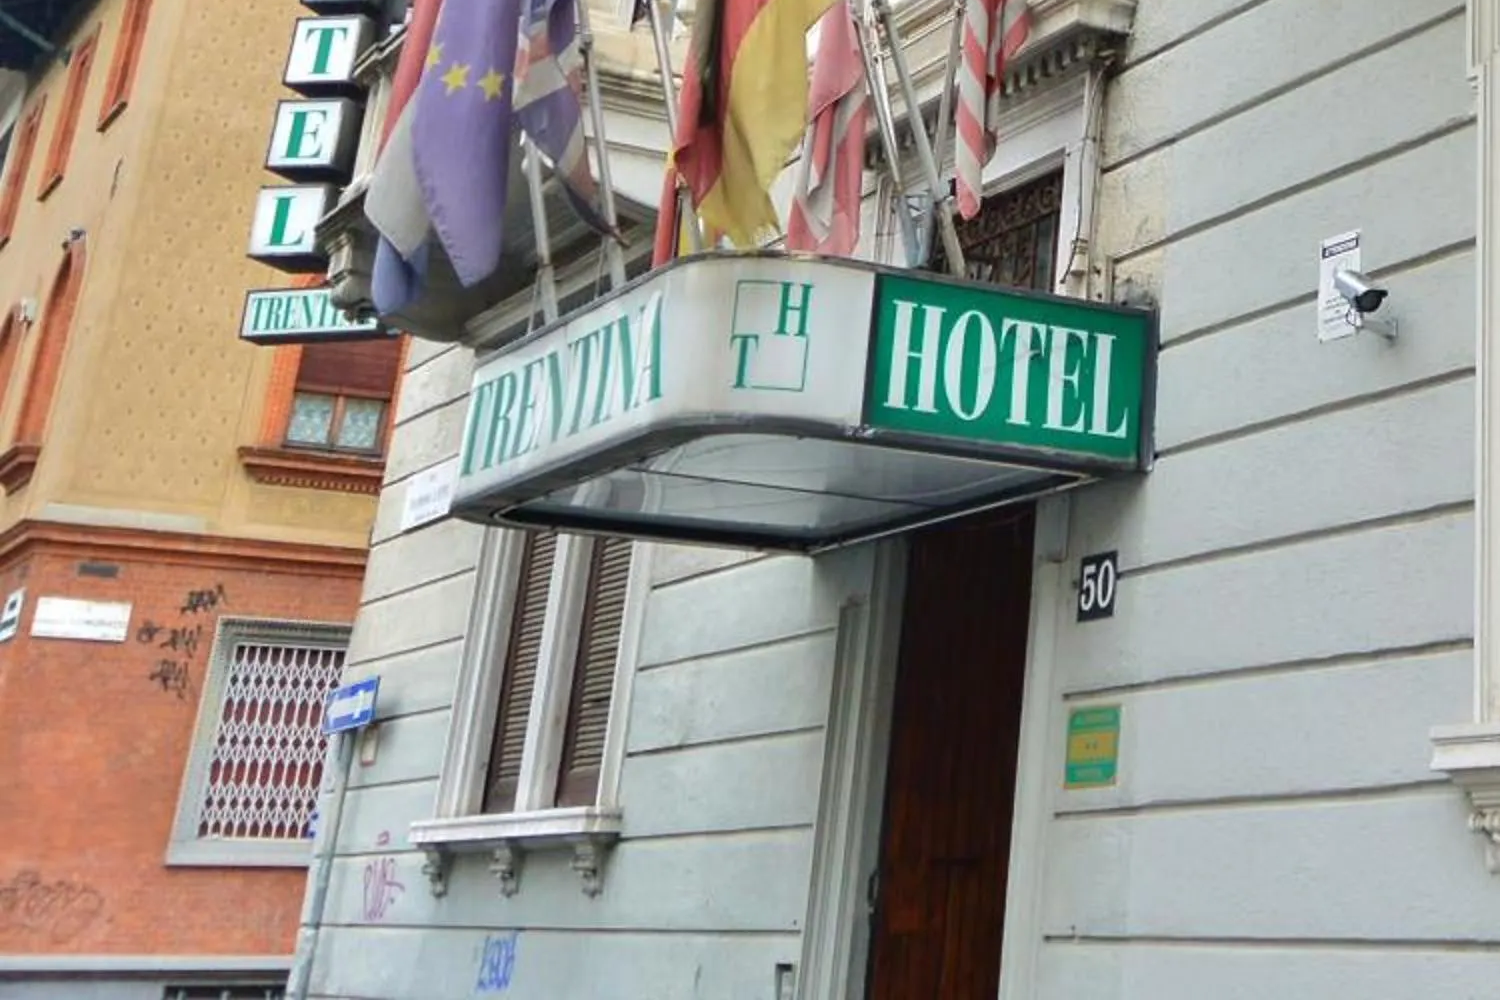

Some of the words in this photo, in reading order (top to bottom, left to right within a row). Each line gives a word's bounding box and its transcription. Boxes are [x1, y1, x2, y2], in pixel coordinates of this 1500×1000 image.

[252, 294, 370, 331] TRENT
[775, 282, 814, 335] H
[461, 292, 663, 476] TRENTINA
[731, 334, 758, 389] T
[884, 300, 1128, 438] HOTEL
[1080, 560, 1115, 611] 50
